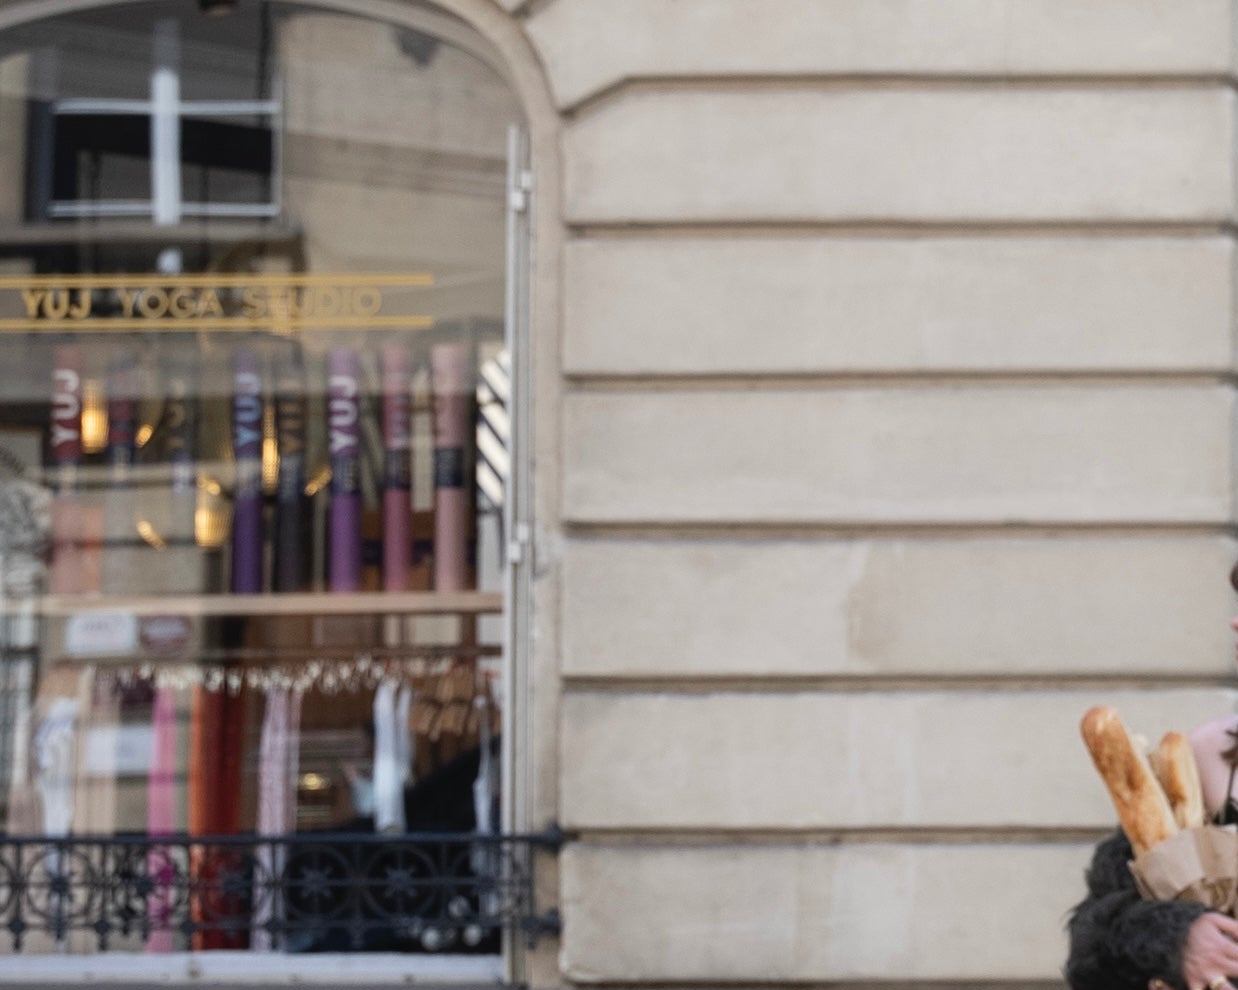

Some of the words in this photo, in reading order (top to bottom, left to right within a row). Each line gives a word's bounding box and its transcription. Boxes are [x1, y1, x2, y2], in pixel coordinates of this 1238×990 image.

[21, 287, 92, 319] YUJ
[116, 287, 226, 319] YOGA
[242, 286, 383, 319] STUDIO
[52, 368, 80, 446] YUJ
[235, 372, 262, 447] YUJ
[329, 375, 358, 453] YUJ
